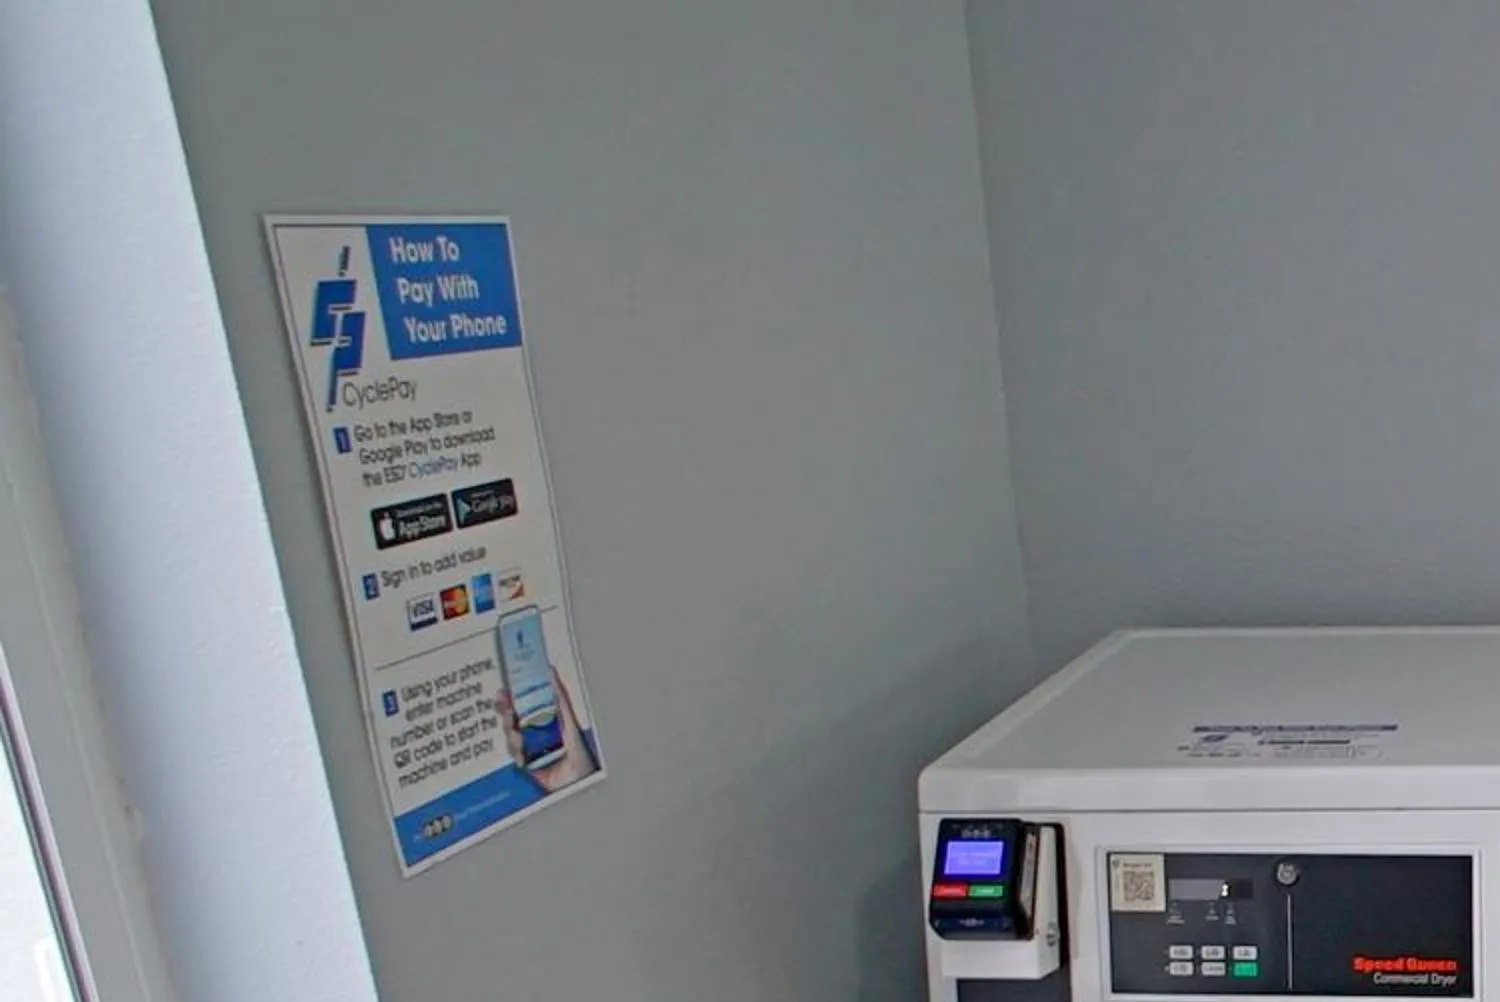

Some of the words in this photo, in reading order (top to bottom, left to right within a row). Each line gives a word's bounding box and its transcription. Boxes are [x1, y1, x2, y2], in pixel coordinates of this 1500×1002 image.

[389, 237, 433, 264] How
[437, 236, 460, 261] To
[397, 277, 433, 307] Pay
[437, 275, 479, 300] With
[404, 316, 447, 343] Your
[451, 313, 507, 339] Phone
[342, 377, 417, 409] CyclePay
[354, 425, 373, 442] Go
[374, 424, 386, 438] to
[389, 421, 407, 435] the
[410, 417, 433, 433] App
[433, 412, 460, 428] Store
[359, 445, 403, 465] Google
[405, 440, 428, 458] Play
[430, 437, 442, 450] to
[444, 427, 495, 449] download
[363, 471, 382, 487] the
[409, 456, 458, 480] CyclePay
[461, 453, 482, 468] App
[381, 568, 407, 588] Sign
[409, 565, 418, 580] in
[420, 561, 432, 575] to
[436, 554, 457, 572] add
[459, 546, 486, 563] value
[413, 600, 435, 618] VISA
[402, 680, 433, 701] Using
[434, 670, 457, 689] your
[406, 701, 434, 721] enter
[436, 682, 483, 706] machine
[390, 721, 434, 749] number
[436, 716, 448, 731] or
[450, 705, 475, 725] scan
[476, 697, 495, 714] the
[394, 750, 412, 769] QR
[415, 740, 443, 760] code
[444, 733, 457, 747] to
[458, 721, 480, 742] start
[481, 715, 498, 732] the
[398, 758, 448, 789] machine
[450, 749, 471, 766] and
[474, 738, 494, 760] pay
[1353, 957, 1404, 973] Speed
